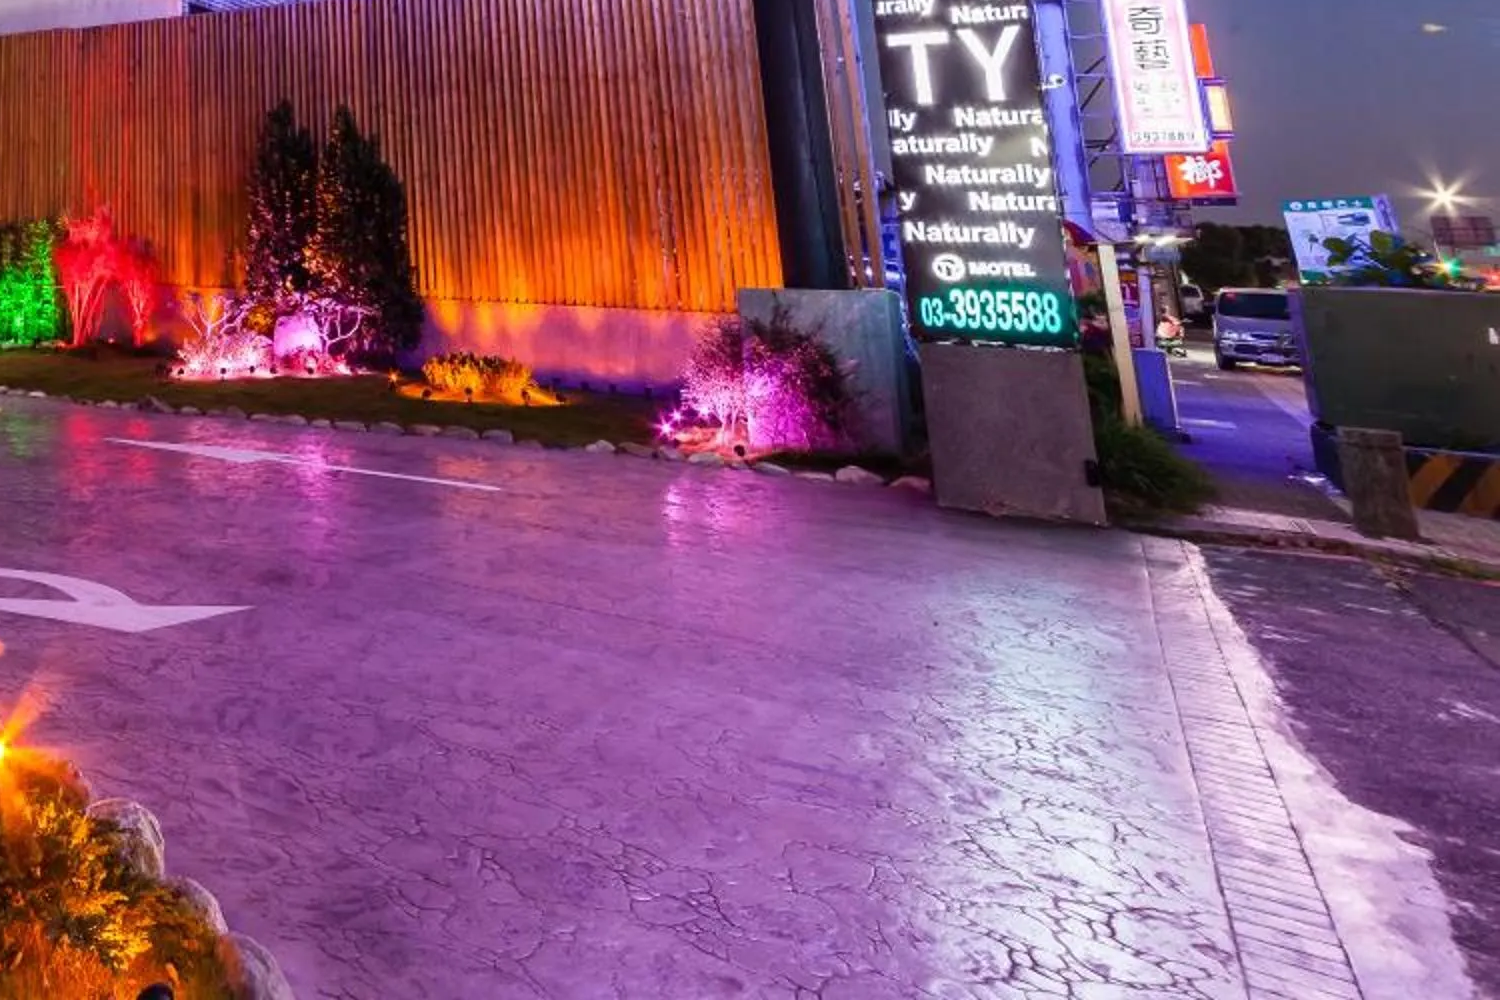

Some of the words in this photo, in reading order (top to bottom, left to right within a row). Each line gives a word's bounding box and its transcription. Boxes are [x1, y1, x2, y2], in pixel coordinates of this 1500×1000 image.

[886, 25, 1021, 107] TY
[925, 164, 1051, 188] Naturally
[904, 221, 1035, 249] Naturally
[967, 261, 1037, 278] MOTEL
[920, 289, 1062, 333] 03-3935588
